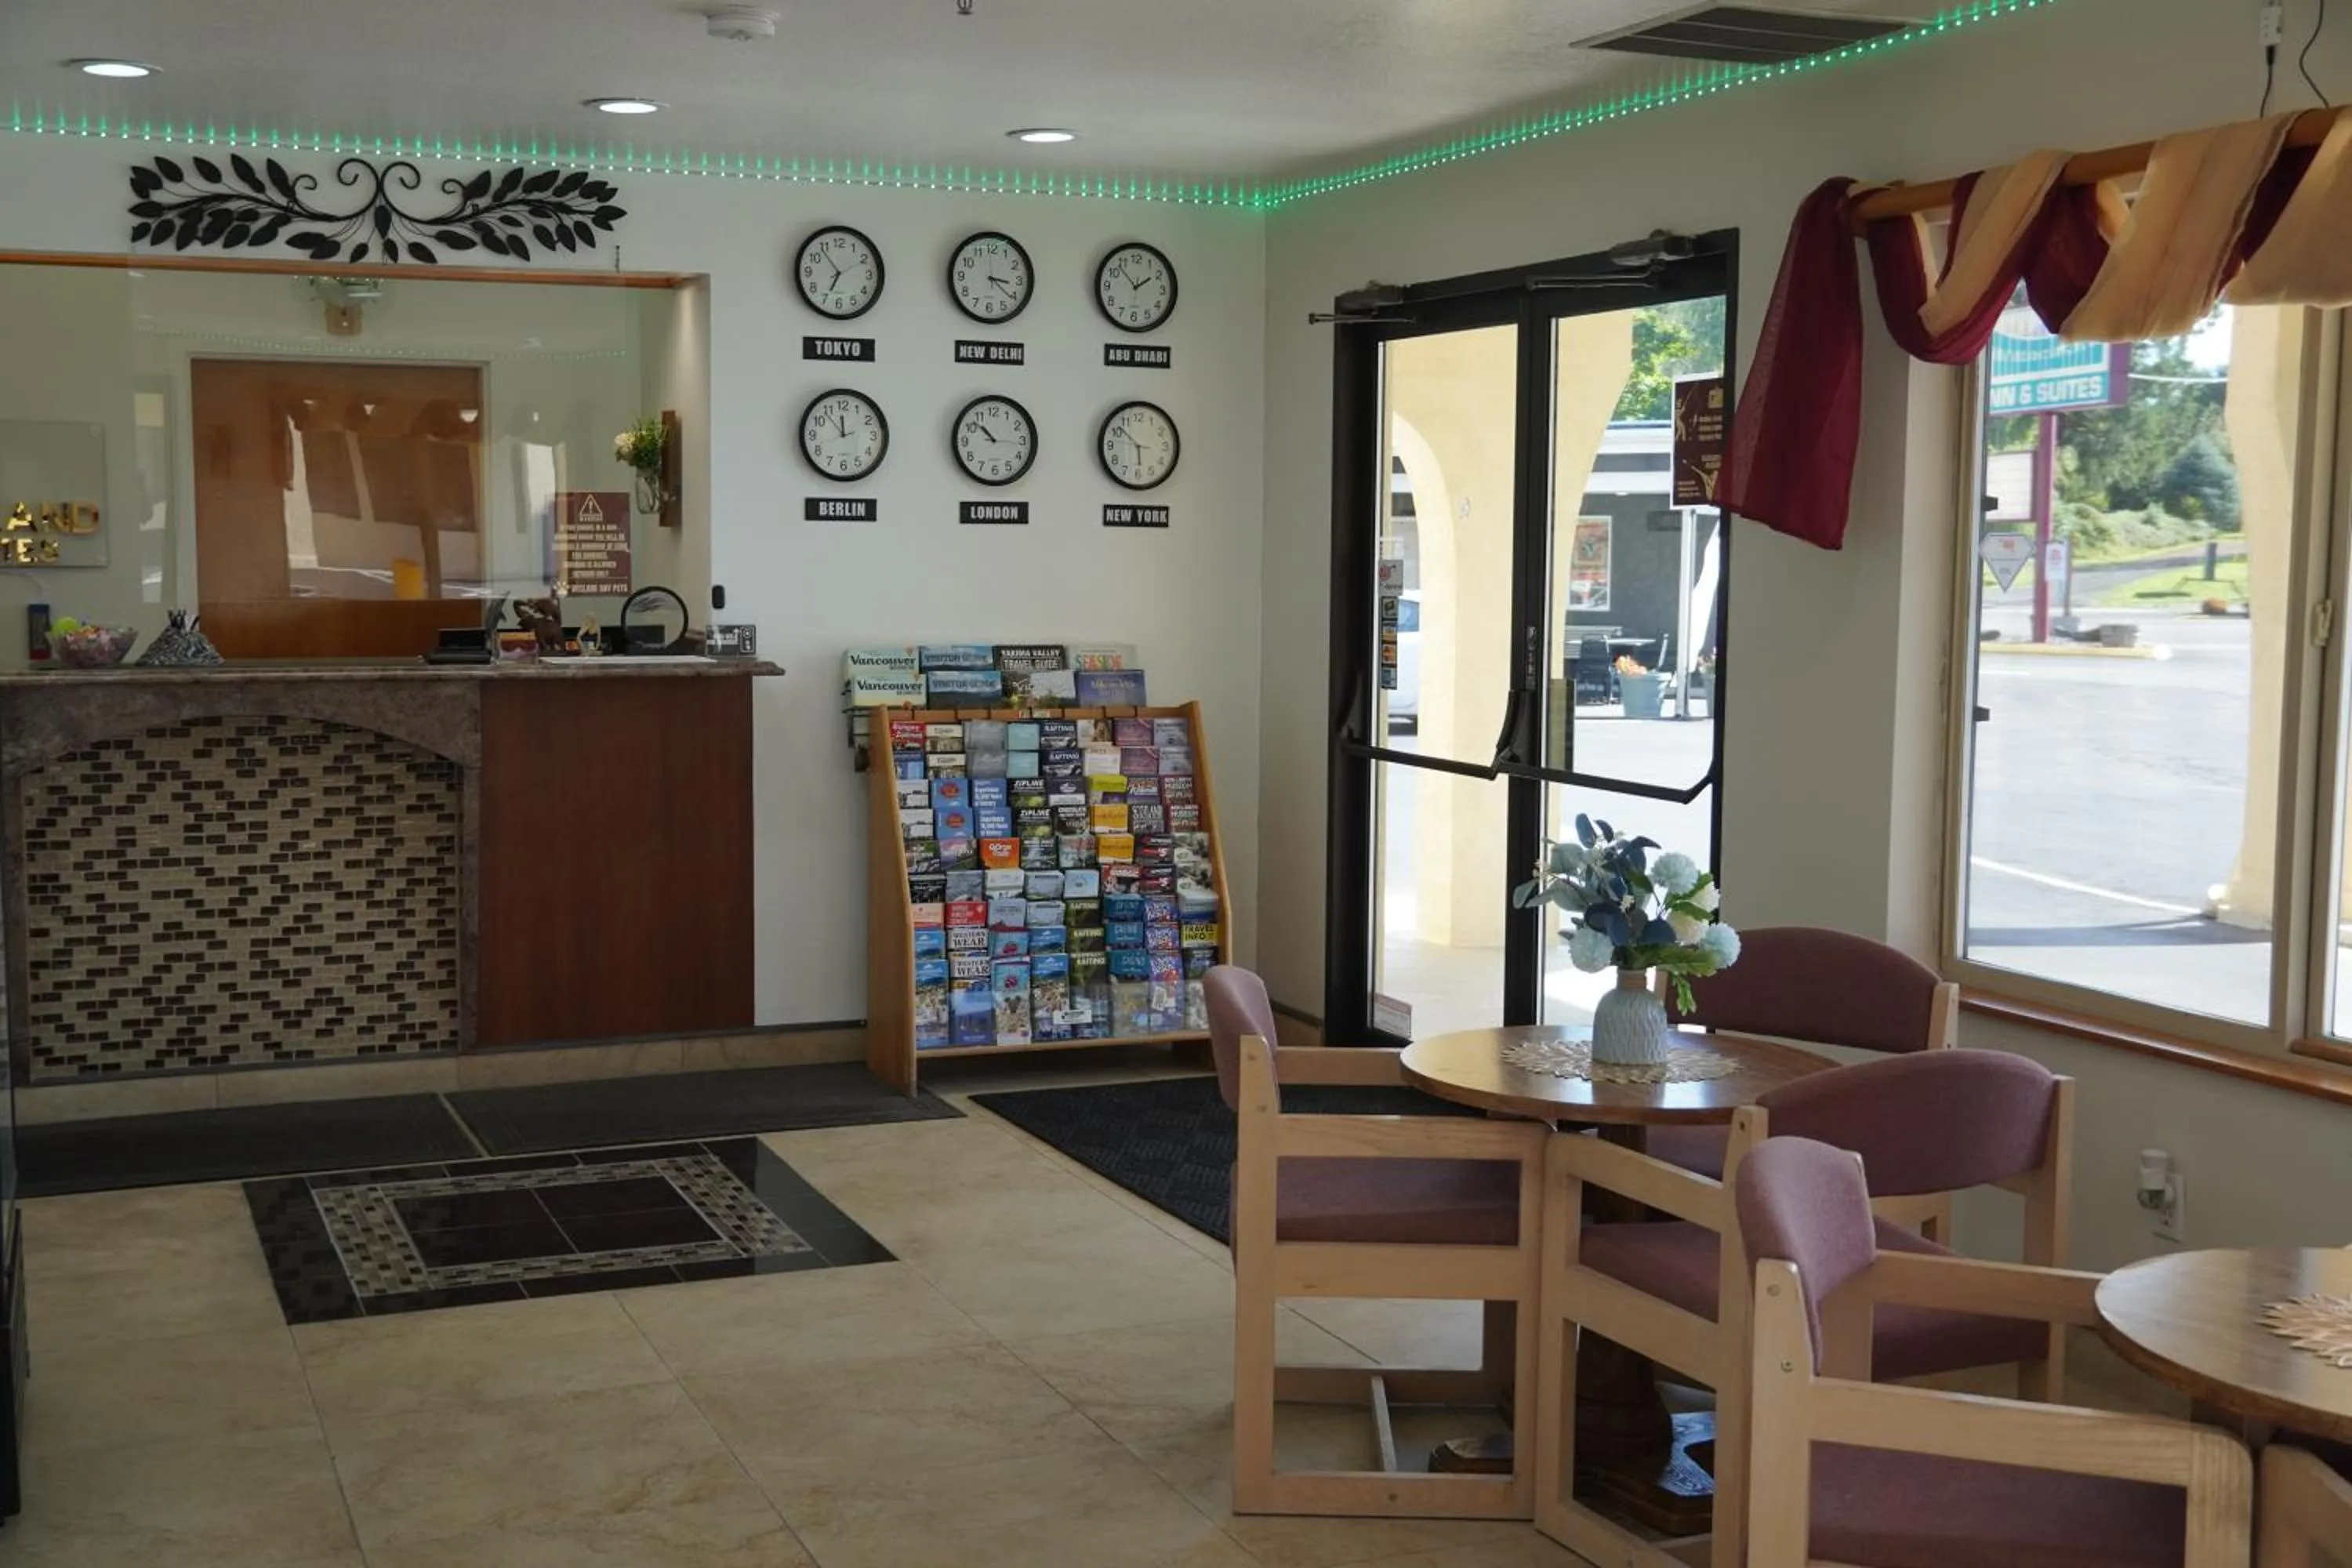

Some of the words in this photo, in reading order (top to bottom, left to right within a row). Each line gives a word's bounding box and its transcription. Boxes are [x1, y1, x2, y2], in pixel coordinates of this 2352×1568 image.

[833, 238, 845, 248] 12
[987, 243, 997, 254] 12
[809, 252, 821, 263] 10
[975, 247, 982, 257] 11
[963, 257, 975, 268] 10
[1131, 253, 1142, 264] 12
[1109, 267, 1120, 278] 10
[815, 340, 861, 357] TOKYO
[960, 344, 985, 358] NEW
[990, 346, 1022, 361] DELHI
[1109, 349, 1130, 361] ABU
[1134, 350, 1167, 363] DHABI
[1990, 387, 2016, 408] NN
[2020, 383, 2032, 405] &
[2036, 376, 2103, 403] SUITES
[823, 405, 833, 416] 11
[837, 401, 849, 412] 12
[988, 407, 1000, 417] 12
[814, 416, 826, 427] 10
[975, 411, 984, 422] 11
[1122, 416, 1130, 427] 11
[1133, 412, 1143, 423] 12
[819, 501, 866, 517] BERLIN
[971, 506, 1018, 520] LONDON
[1106, 509, 1131, 522] NEW
[1138, 510, 1167, 524] YORK
[851, 654, 916, 666] Vancouver
[857, 679, 924, 691] Vancouver
[952, 937, 986, 947] WEAR
[956, 965, 990, 975] WEAR
